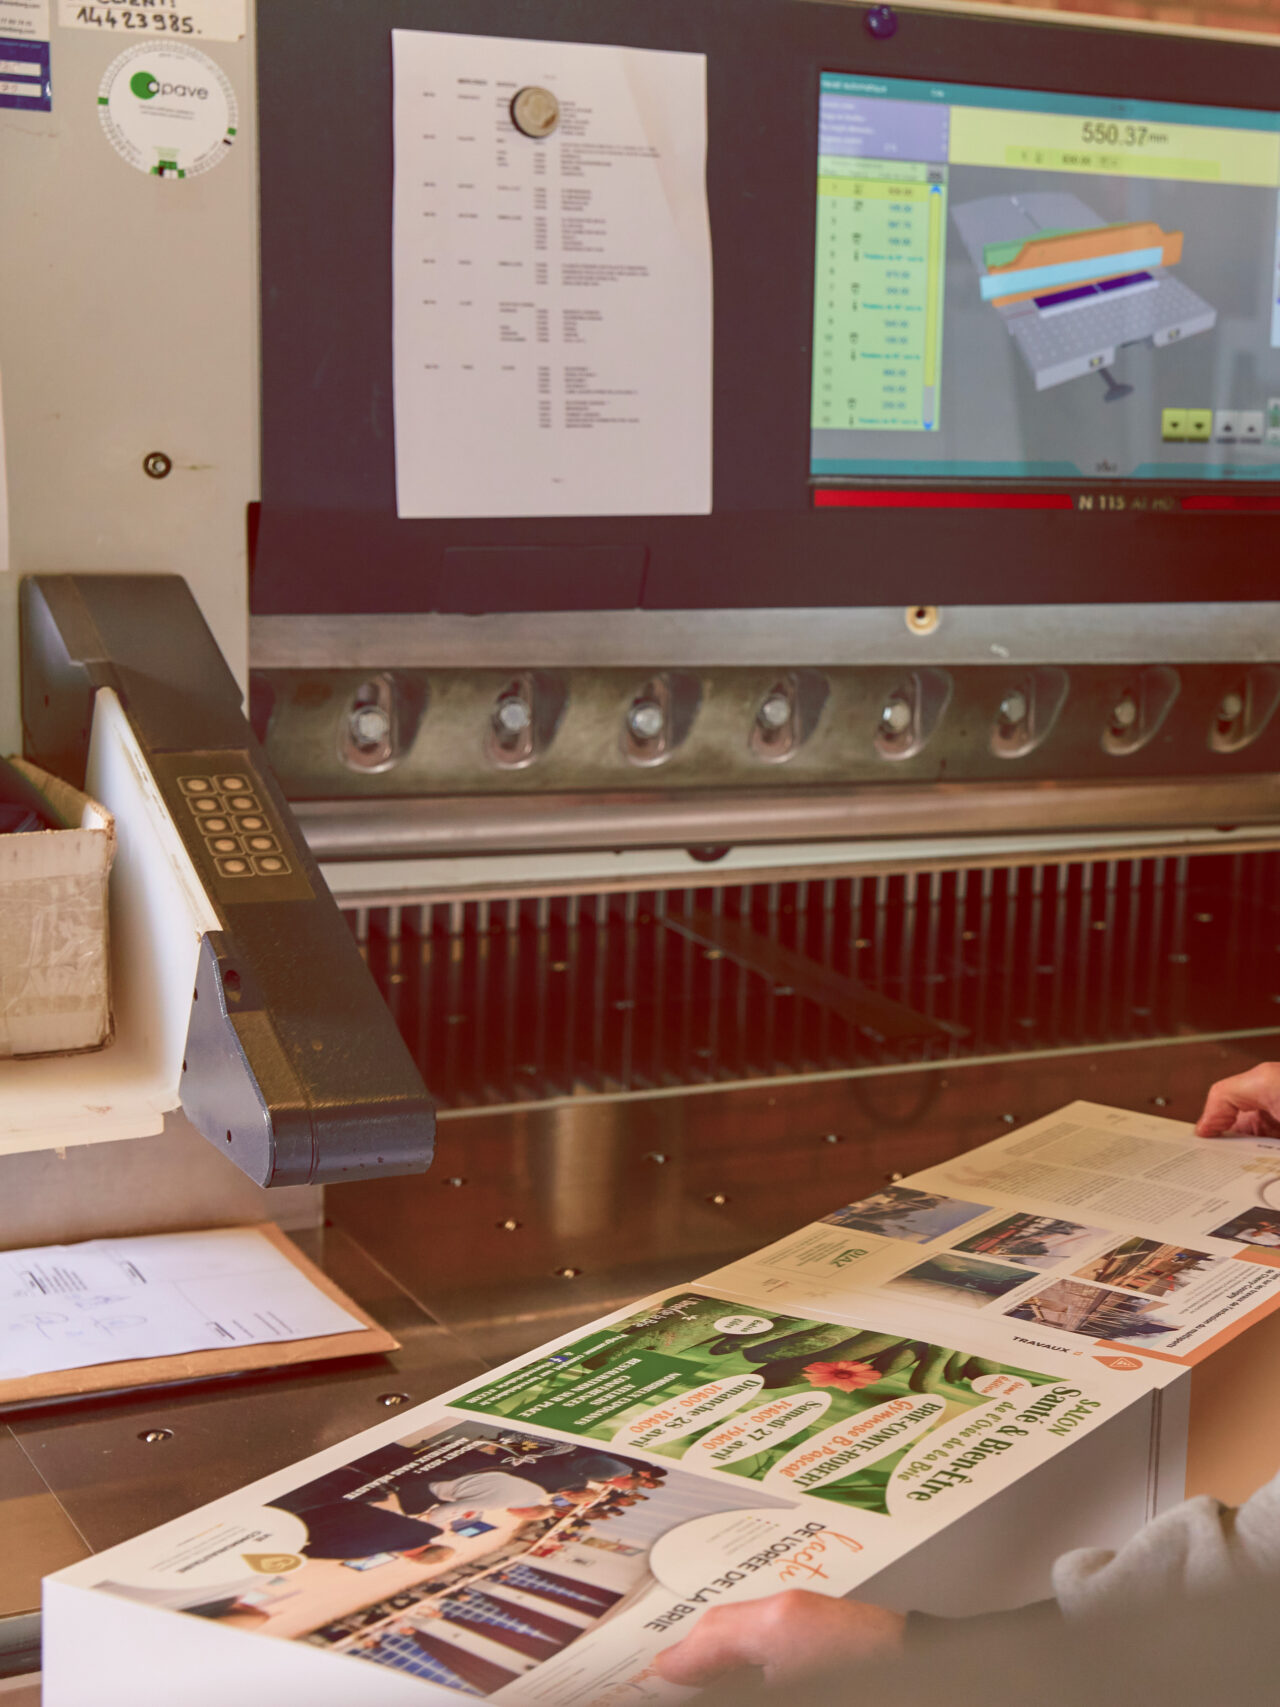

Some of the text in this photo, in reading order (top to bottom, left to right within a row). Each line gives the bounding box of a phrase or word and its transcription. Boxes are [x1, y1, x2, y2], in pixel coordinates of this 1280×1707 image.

[77, 6, 202, 34] 14423985.
[147, 80, 209, 100] apave
[1079, 494, 1093, 511] N
[830, 1247, 868, 1268] DIAZ
[739, 1318, 764, 1333] Entrée
[582, 1332, 629, 1356] Programme
[1011, 1335, 1070, 1353] TRAVAUX
[538, 1368, 555, 1377] sur
[551, 1353, 585, 1371] complet
[516, 1357, 641, 1417] RESTAURATION SUR PLACE
[561, 1374, 631, 1407] CONFÉRENCES
[573, 1371, 681, 1425] NOMBREUX EXPOSANTS
[588, 1382, 636, 1405] ATELIERS
[678, 1383, 722, 1407] 10h00
[627, 1378, 764, 1448] Dimanche 28 avril
[628, 1409, 674, 1433] 18h00
[749, 1399, 792, 1423] 14h00
[1046, 1398, 1101, 1437] SALON
[701, 1425, 745, 1450] 19h00
[709, 1401, 822, 1461] Samedi 27 avril
[778, 1399, 914, 1478] Gymnase B. Pascal
[887, 1400, 1016, 1481] de l'Orée de la Brie
[906, 1385, 1081, 1501] Santé & Bien-Être
[415, 1436, 469, 1463] AMBITIEUX
[442, 1439, 486, 1460] BUDGET
[793, 1402, 942, 1487] BRIE-COMTE-ROBERT
[389, 1461, 419, 1476] MAIS
[342, 1473, 394, 1500] RÉALISTE
[792, 1521, 826, 1538] DE
[737, 1535, 801, 1572] L'ORÉE
[711, 1570, 746, 1588] DE
[685, 1586, 720, 1603] LA
[643, 1603, 695, 1632] BRIE
